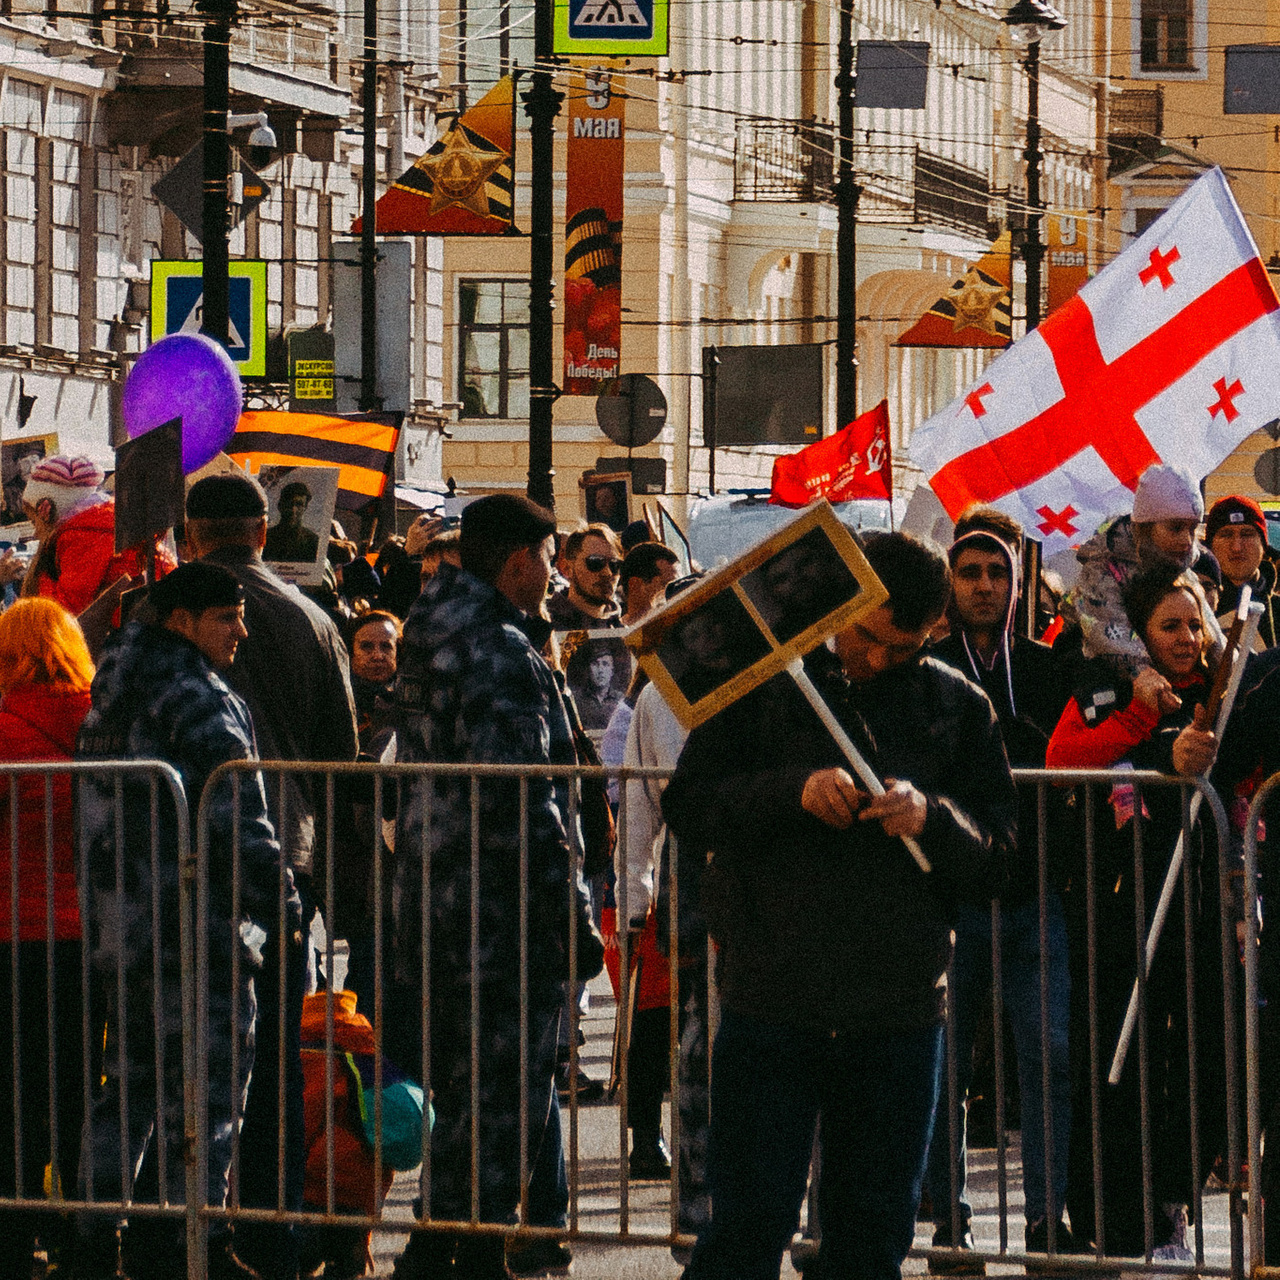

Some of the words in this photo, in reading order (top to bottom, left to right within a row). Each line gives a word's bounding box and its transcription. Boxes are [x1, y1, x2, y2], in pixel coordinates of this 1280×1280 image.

[573, 117, 620, 138] мая
[1060, 213, 1076, 245] 9
[588, 344, 618, 360] День
[568, 361, 617, 382] Победы!
